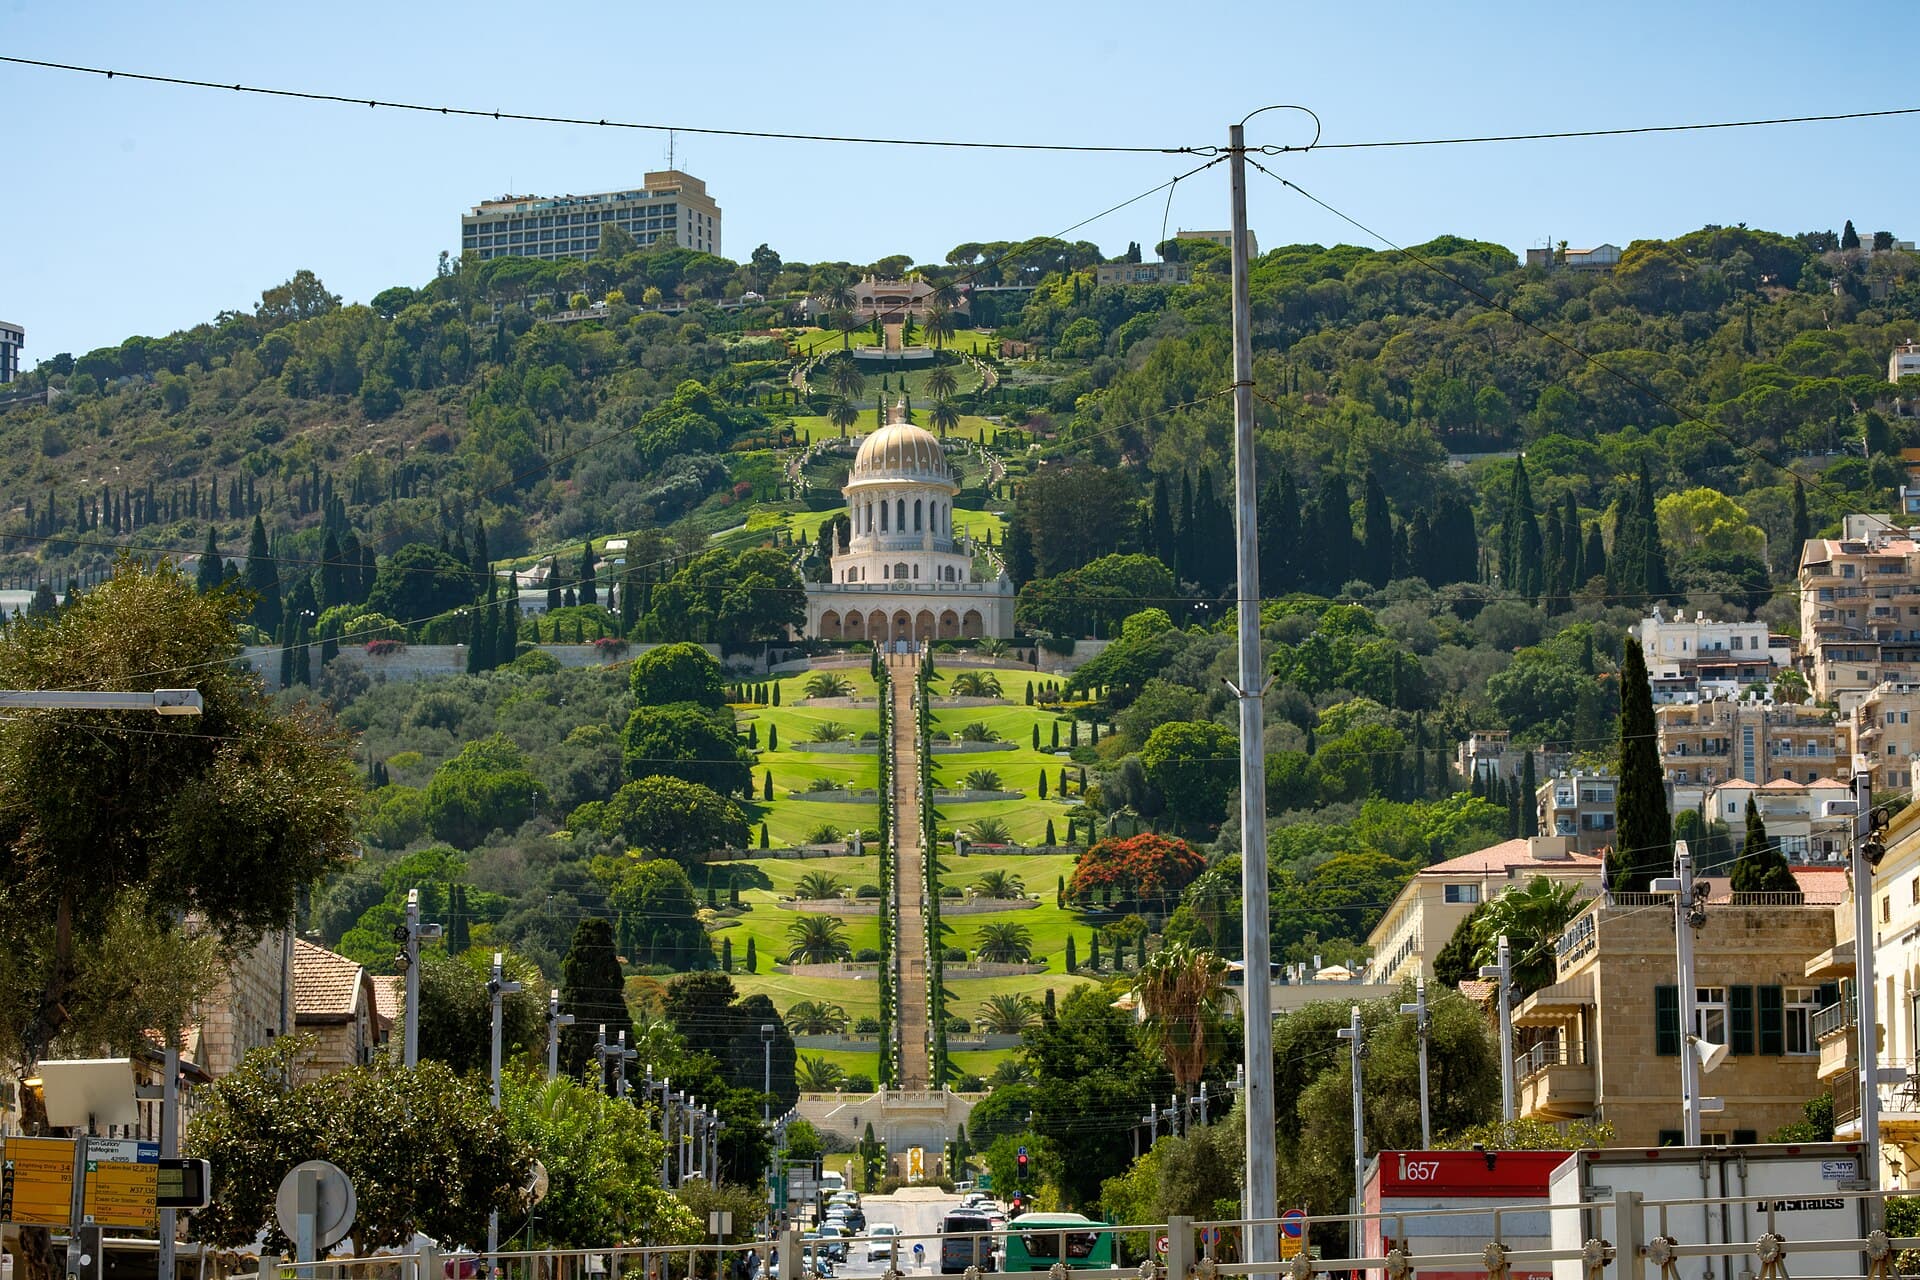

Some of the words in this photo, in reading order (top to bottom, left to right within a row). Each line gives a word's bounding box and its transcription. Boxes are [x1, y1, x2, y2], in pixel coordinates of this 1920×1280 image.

[531, 207, 571, 217] CARMEL
[1408, 1161, 1440, 1180] 657
[142, 1208, 152, 1216] 79
